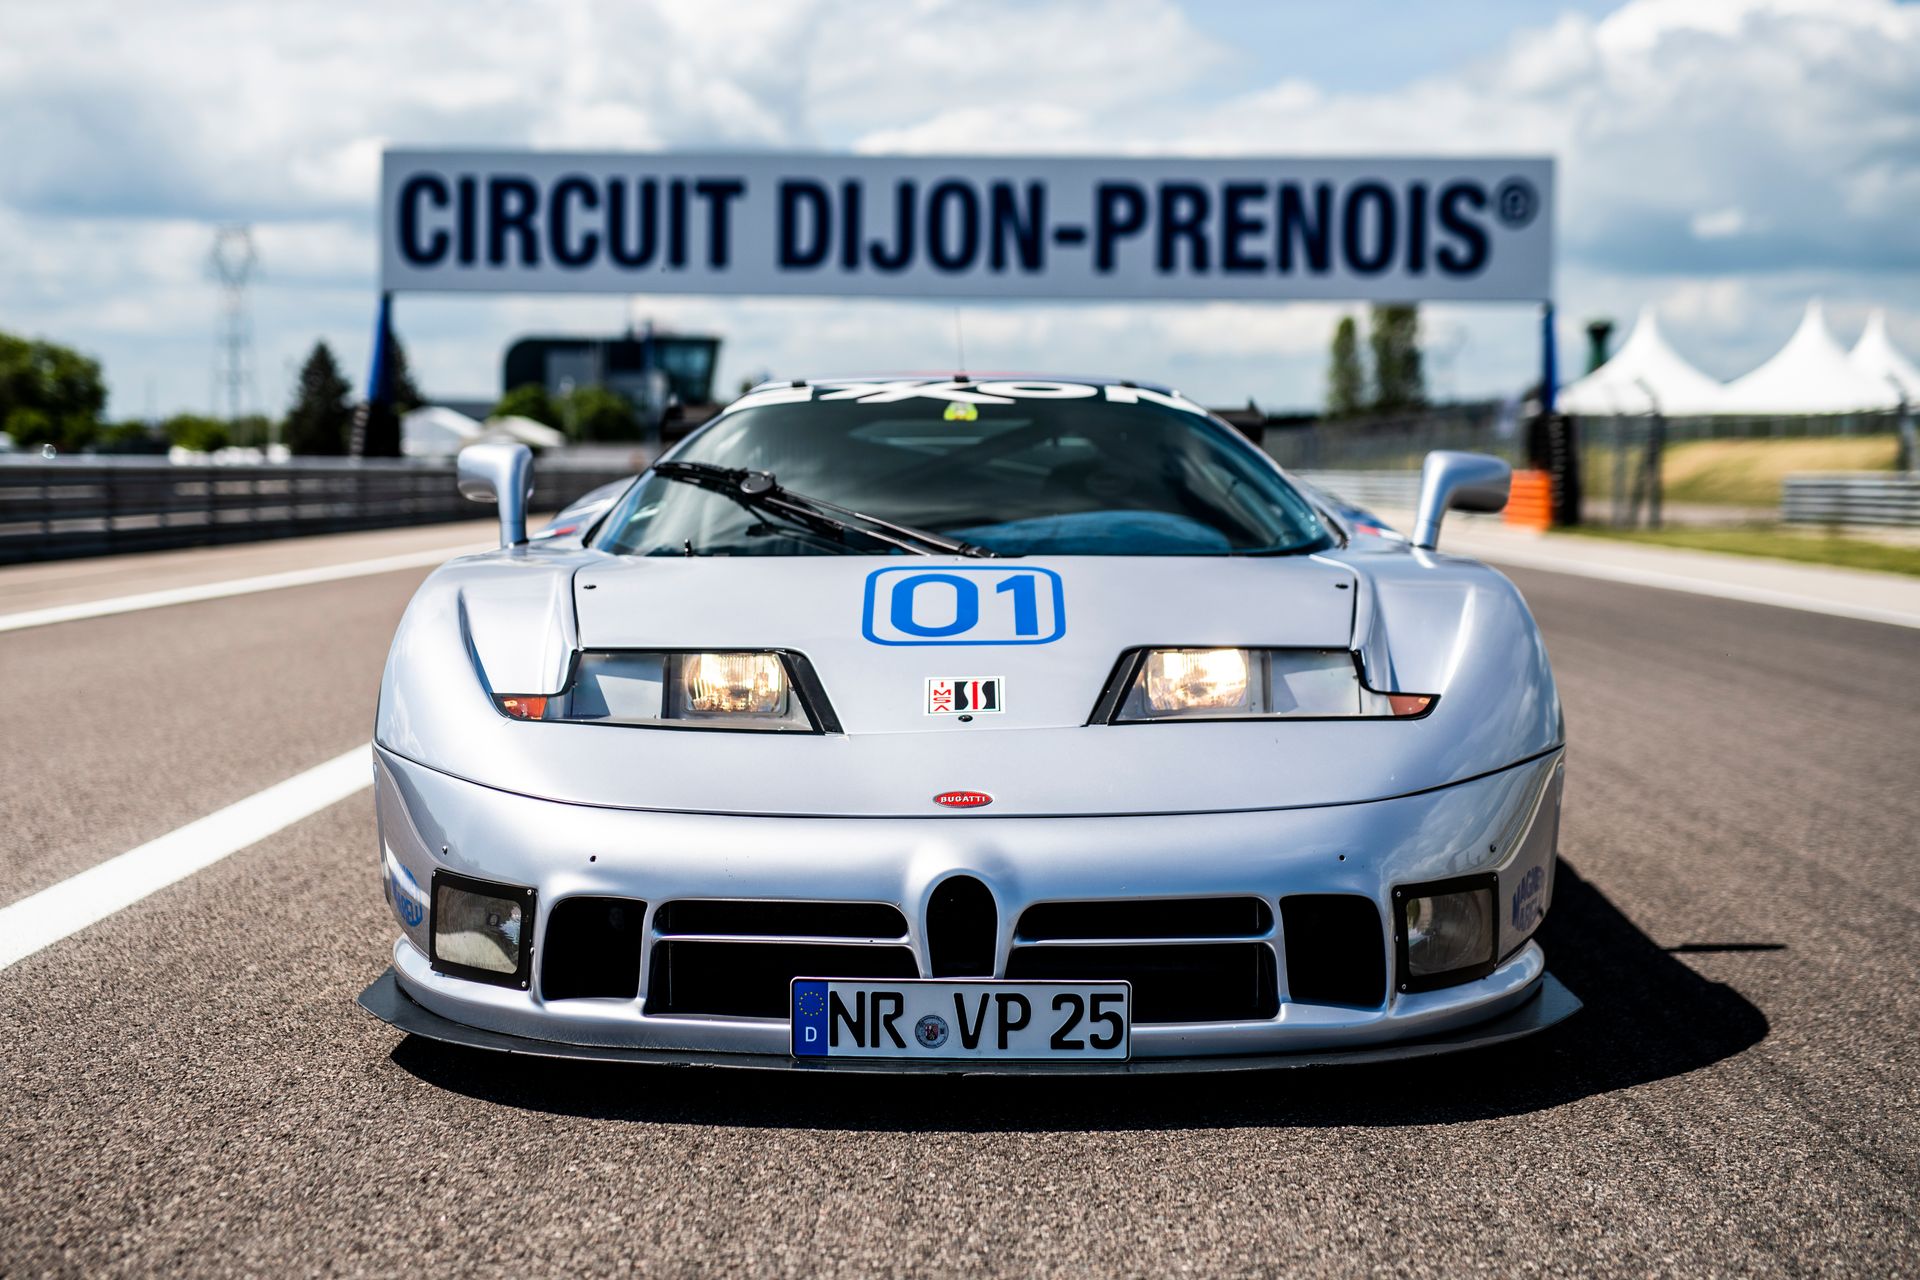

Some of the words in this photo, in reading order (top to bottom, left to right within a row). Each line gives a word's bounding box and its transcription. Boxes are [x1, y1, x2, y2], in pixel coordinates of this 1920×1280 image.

[397, 171, 747, 271] CIRCUIT
[890, 573, 1039, 638] 01
[805, 1026, 817, 1042] D
[829, 990, 907, 1049] NR
[953, 992, 1031, 1050] VP
[1049, 993, 1124, 1050] 25
